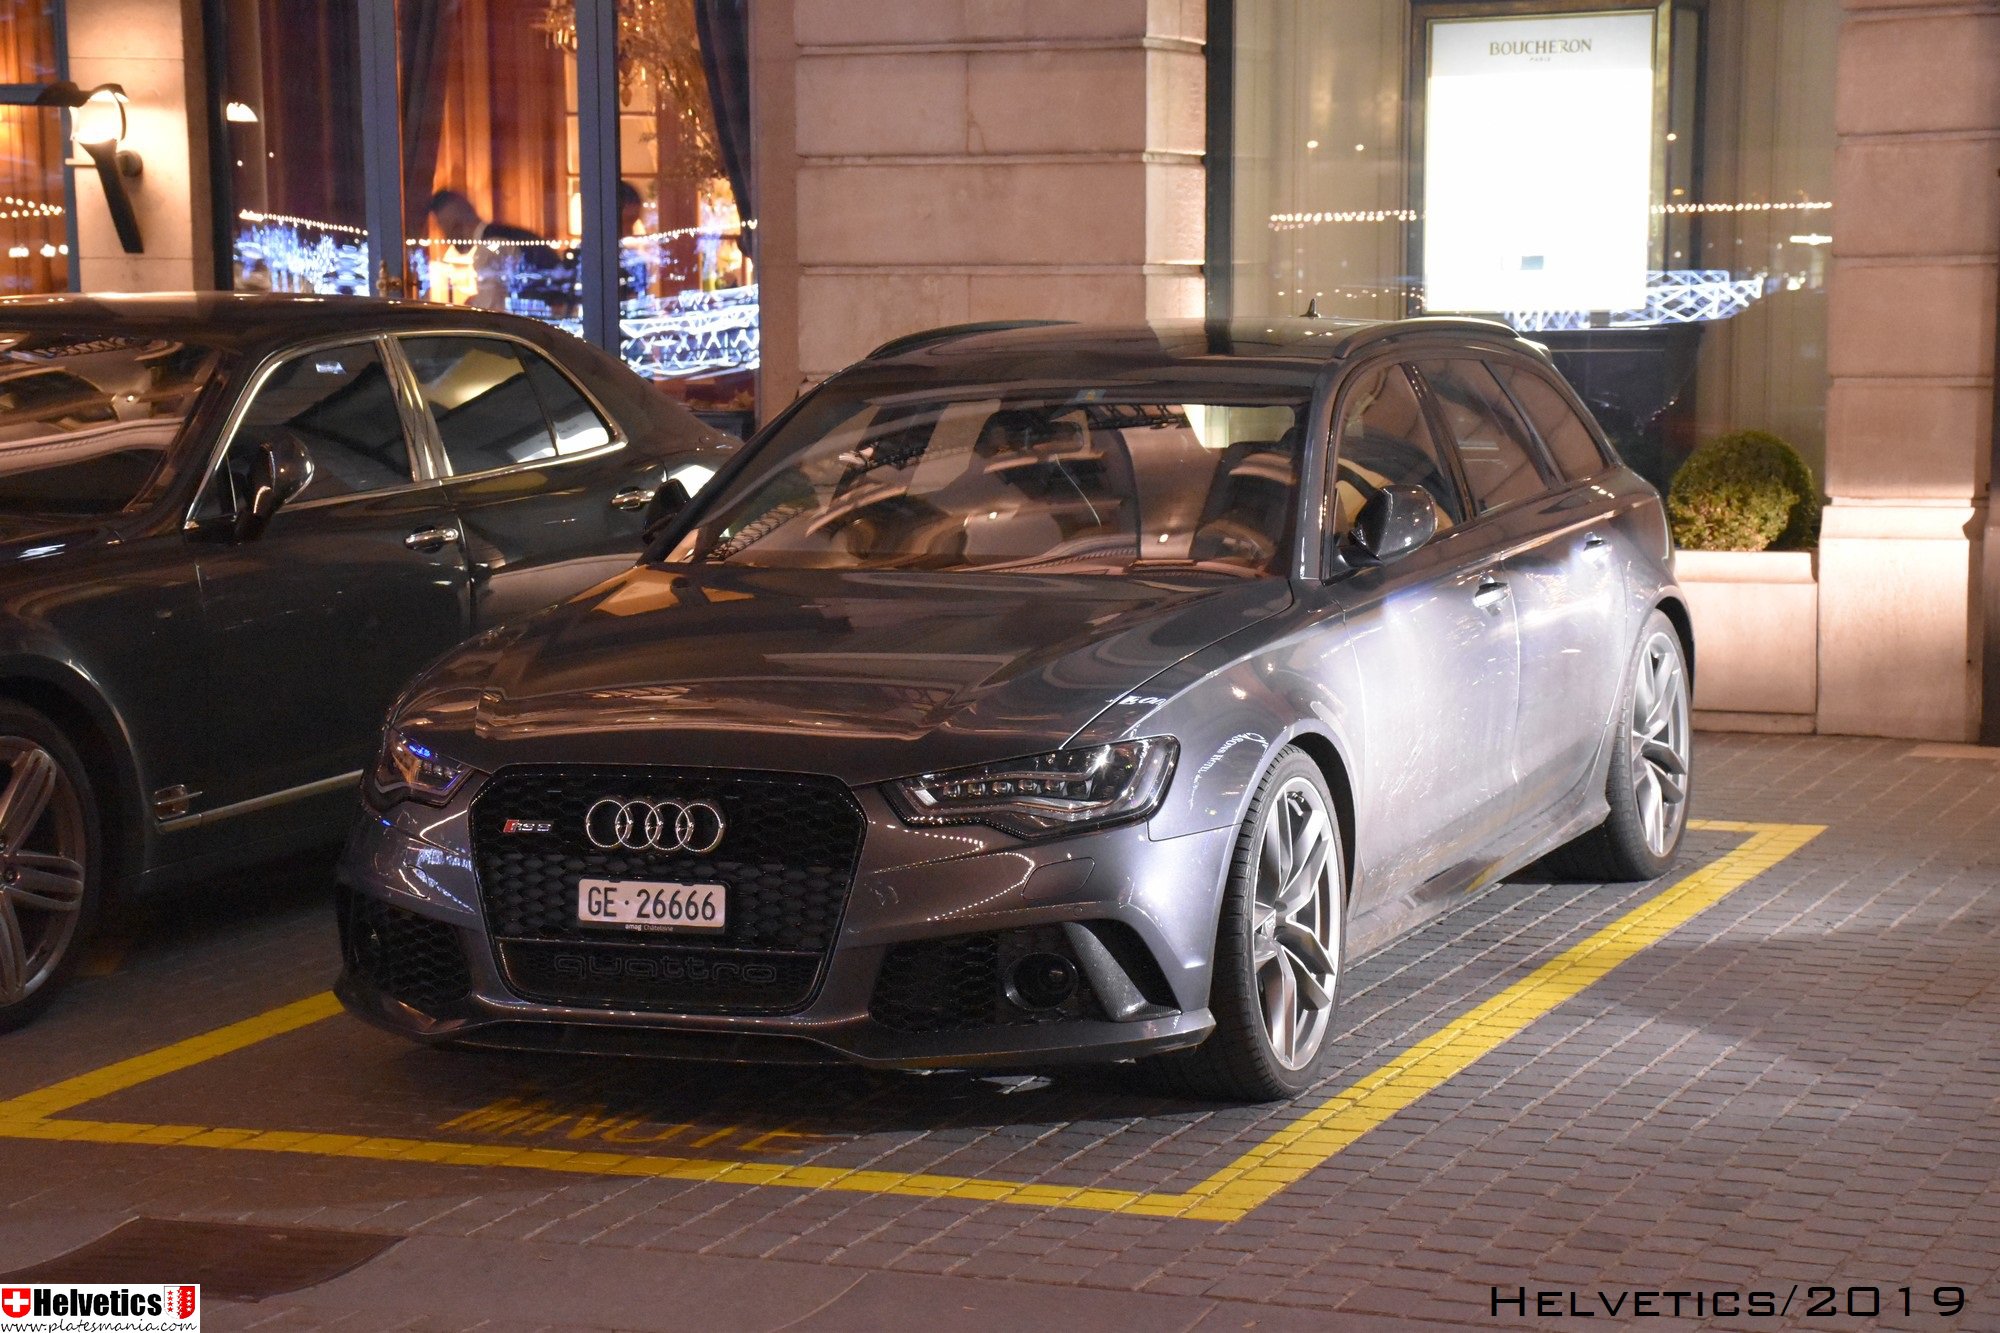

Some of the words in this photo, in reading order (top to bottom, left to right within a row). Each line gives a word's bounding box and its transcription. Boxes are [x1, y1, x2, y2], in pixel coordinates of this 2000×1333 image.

[1489, 39, 1592, 55] BOUCHERON
[587, 886, 618, 918] GE
[636, 888, 717, 921] 26666
[624, 923, 642, 931] amag
[554, 954, 777, 983] quattro
